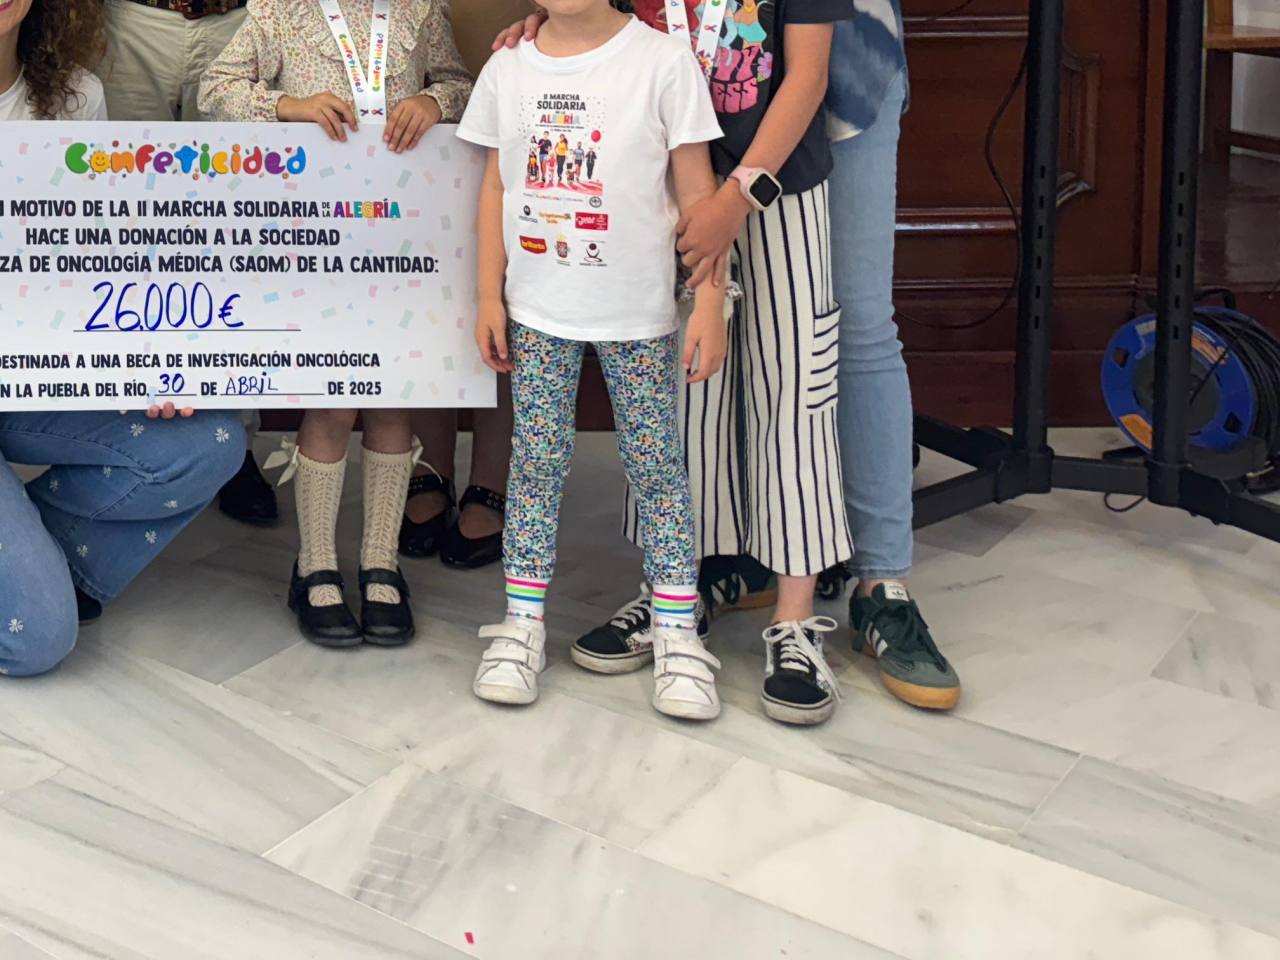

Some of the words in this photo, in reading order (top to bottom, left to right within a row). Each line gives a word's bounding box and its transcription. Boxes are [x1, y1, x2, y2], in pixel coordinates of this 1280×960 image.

[537, 100, 586, 111] SOLIDARIA
[11, 200, 76, 217] MOTIVO
[83, 200, 103, 217] DE
[110, 200, 130, 217] LA
[137, 200, 147, 217] II
[153, 200, 227, 217] MARCHA
[234, 200, 319, 218] SOLIDARIA
[322, 201, 330, 209] DE
[333, 198, 401, 218] ALEGRÍA
[322, 210, 330, 218] LA
[26, 228, 68, 245] HACE
[76, 228, 112, 245] UNA
[119, 224, 206, 245] DONACIÓN
[214, 228, 225, 245] A
[232, 228, 252, 245] LA
[259, 228, 340, 245] SOCIEDAD
[29, 255, 50, 272] DE
[57, 251, 151, 273] ONCOLOGÍA
[159, 251, 223, 273] MÉDICA
[230, 255, 290, 273] (SAOM)
[297, 255, 317, 272] DE
[324, 255, 343, 272] LA
[351, 255, 439, 273] CANTIDAD:
[76, 354, 86, 368] A
[91, 354, 121, 368] UNA
[127, 354, 161, 368] BECA
[167, 354, 183, 368] DE
[188, 351, 290, 368] INVESTIGACIÓN
[297, 351, 381, 368] ONCOLÓGICA
[16, 384, 32, 398] LA
[38, 383, 90, 398] PUEBLA
[96, 383, 119, 397] DEL
[159, 373, 185, 394] 30
[201, 382, 217, 396] DE
[328, 382, 344, 396] DE
[350, 381, 381, 395] 2025
